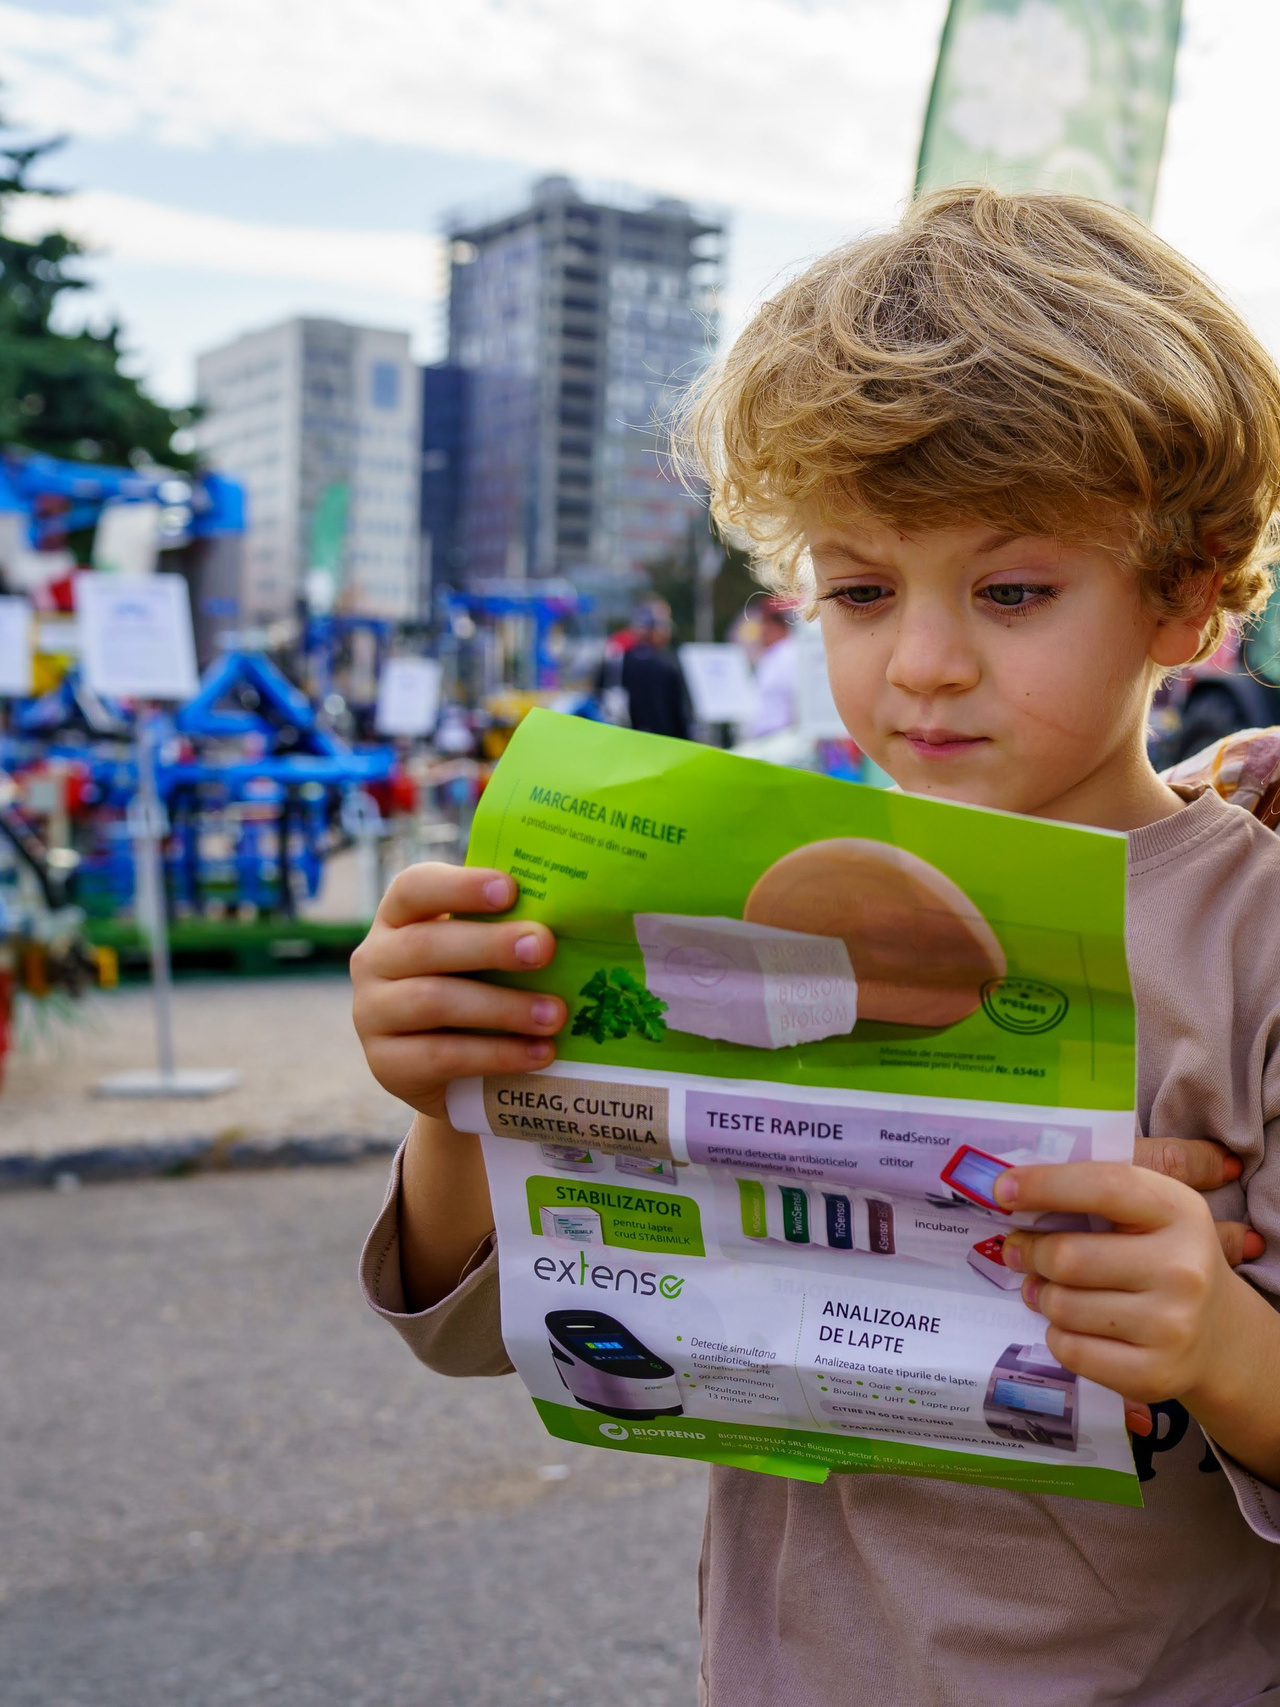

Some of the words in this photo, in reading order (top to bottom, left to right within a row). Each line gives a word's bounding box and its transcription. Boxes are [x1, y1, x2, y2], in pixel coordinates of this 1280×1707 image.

[530, 786, 607, 824] MARCAREA
[610, 809, 628, 831] IN
[630, 815, 688, 846] RELIEF
[521, 814, 527, 823] a
[527, 816, 568, 836] produselor
[569, 828, 597, 848] lactate
[605, 838, 620, 852] din
[621, 845, 648, 861] carne
[497, 1088, 568, 1115] CHEAG,
[573, 1097, 654, 1121] CULTURI
[498, 1113, 585, 1137] STARTER,
[589, 1123, 658, 1145] SEDILA
[707, 1111, 765, 1133] TESTE
[771, 1118, 844, 1141] RAPIDE
[879, 1129, 951, 1146] ReadSensor
[707, 1145, 743, 1156] pentru
[745, 1149, 788, 1162] detectia
[789, 1153, 859, 1168] antibioticelor
[879, 1155, 914, 1168] cititor
[799, 1167, 825, 1177] lapte
[556, 1186, 682, 1218] STABILIZATOR
[613, 1218, 646, 1230] pentru
[648, 1223, 674, 1233] lapte
[915, 1219, 970, 1235] incubator
[614, 1229, 637, 1240] crud
[639, 1232, 691, 1245] STABIMILK
[822, 1300, 942, 1334] ANALIZOARE
[690, 1337, 729, 1352] Detectie
[729, 1344, 777, 1360] simultana
[819, 1325, 844, 1344] DE
[848, 1330, 905, 1354] LAPTE
[698, 1354, 760, 1369] antibioticelor
[814, 1354, 866, 1372] Analizeaza
[868, 1363, 894, 1376] toate
[896, 1368, 932, 1380] tipurile
[934, 1372, 947, 1383] de
[949, 1375, 978, 1387] lapte:
[712, 1374, 775, 1388] contaminanti
[829, 1375, 853, 1385] Vaca
[868, 1381, 891, 1391] Oaie
[907, 1386, 937, 1397] Capra
[704, 1384, 747, 1397] Rezultate
[758, 1392, 780, 1402] doar
[720, 1395, 753, 1405] minute
[833, 1387, 869, 1399] Bivolita
[885, 1395, 905, 1404] UHT
[921, 1400, 948, 1409] Lapte
[950, 1405, 970, 1413] praf
[832, 1405, 863, 1415] CITIRE
[906, 1416, 955, 1427] SECUNDE
[631, 1427, 706, 1440] BIOTREND
[980, 1439, 1025, 1449] ANALIZA
[718, 1433, 763, 1443] BIOTREND
[764, 1436, 786, 1445] PLUS
[807, 1442, 846, 1456] Bucuresti,
[848, 1451, 873, 1460] sector
[805, 1452, 835, 1464] mobile:
